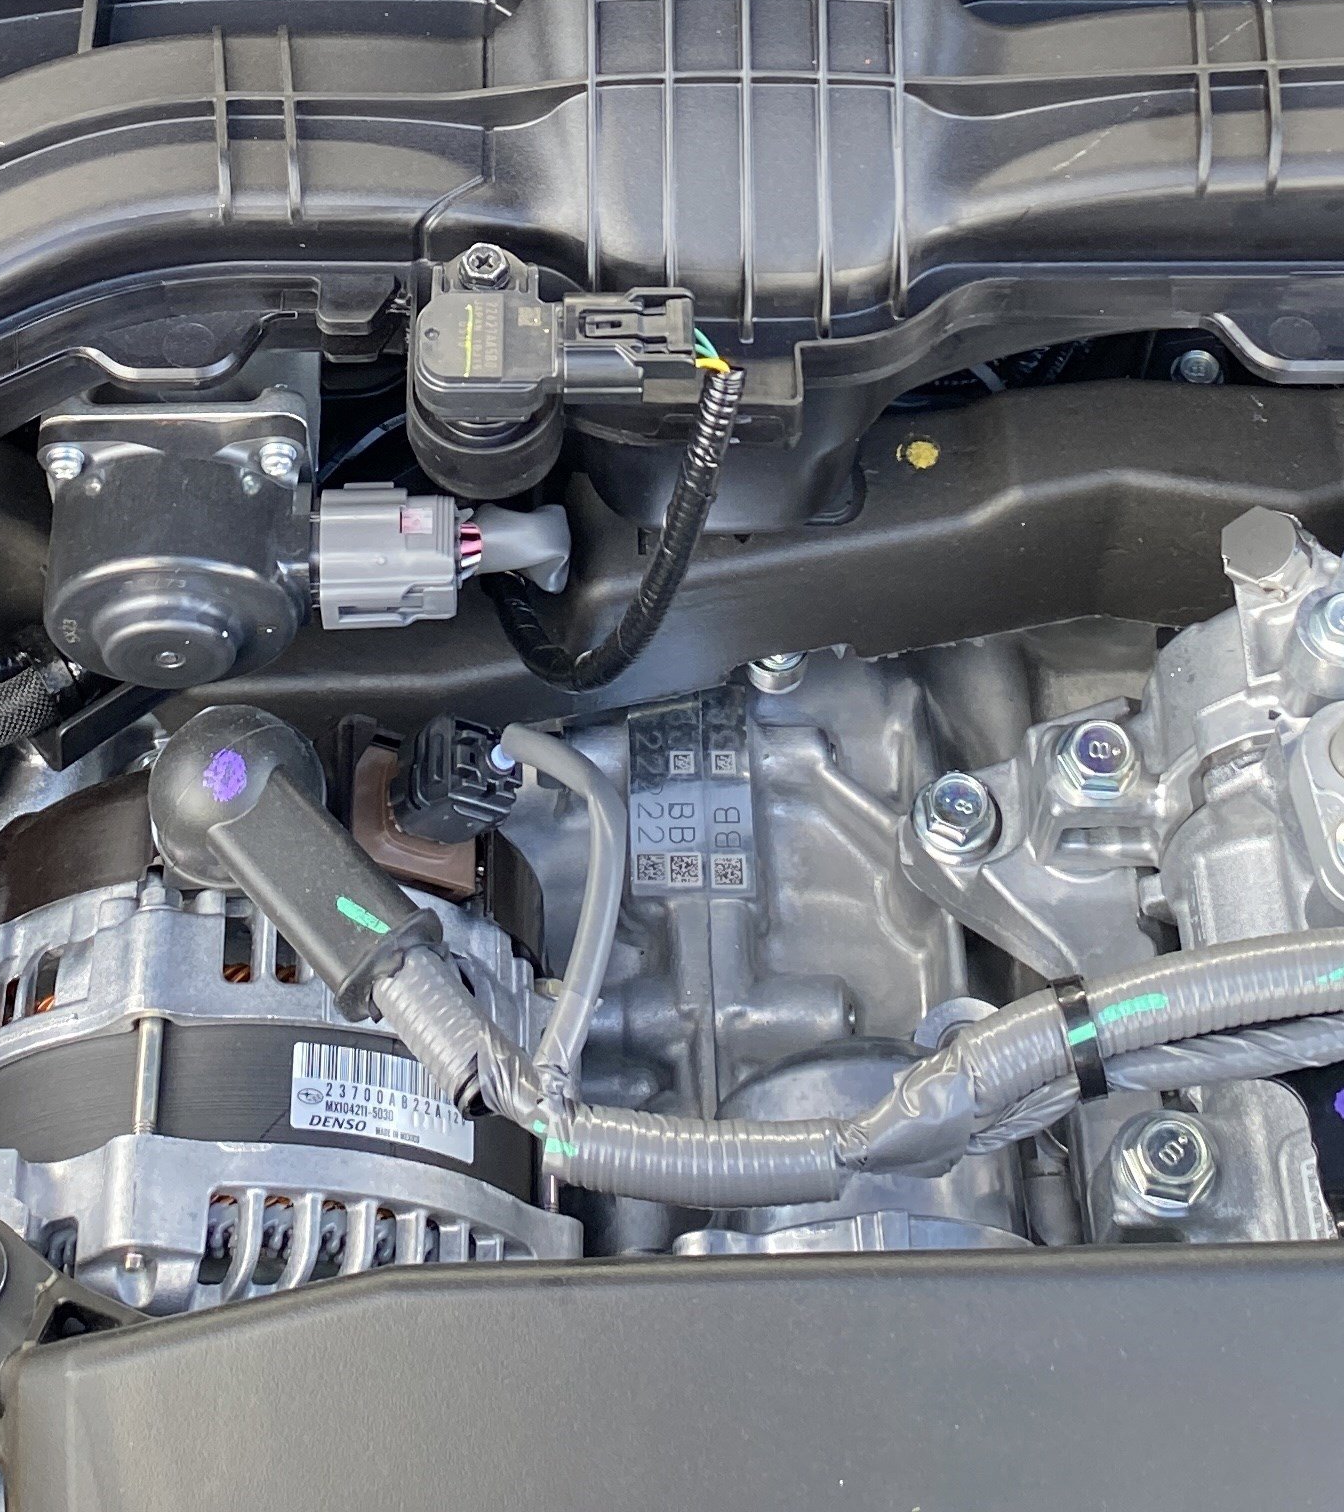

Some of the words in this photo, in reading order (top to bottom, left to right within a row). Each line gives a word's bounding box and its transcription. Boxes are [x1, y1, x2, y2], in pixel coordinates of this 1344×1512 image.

[668, 802, 696, 844] BB
[325, 1100, 394, 1121] MX104211-5030
[309, 1115, 367, 1131] DENSO
[375, 1127, 390, 1137] MADE
[393, 1129, 399, 1138] IN
